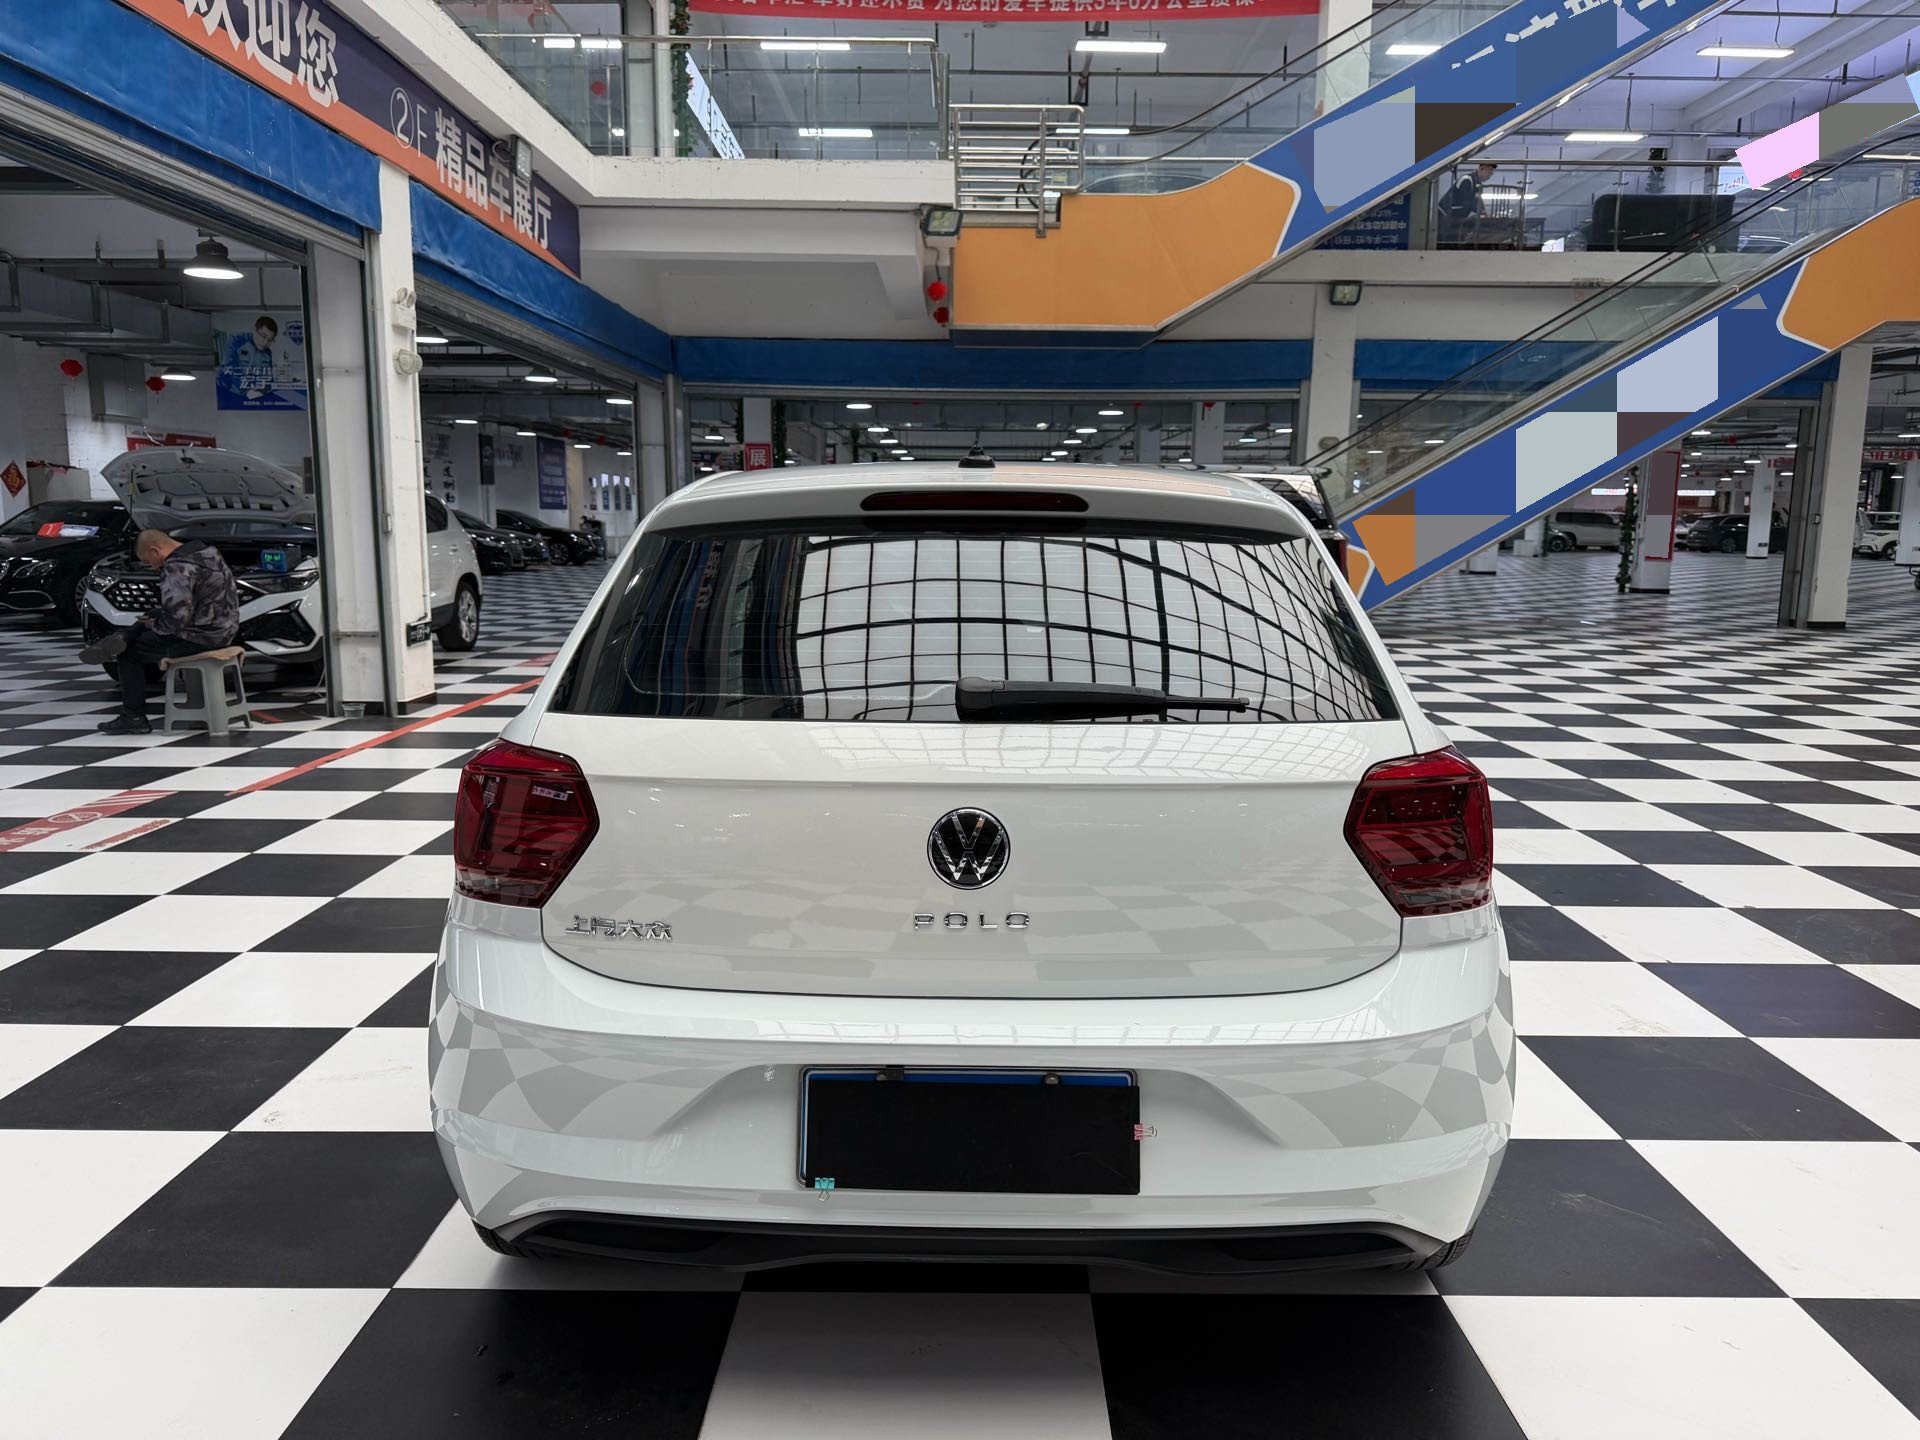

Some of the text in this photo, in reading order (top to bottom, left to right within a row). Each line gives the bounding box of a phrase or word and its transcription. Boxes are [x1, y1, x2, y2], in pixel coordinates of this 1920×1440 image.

[435, 107, 551, 249] 精品车展厅
[565, 915, 672, 940] 上汽大众
[914, 912, 1030, 929] POLO
